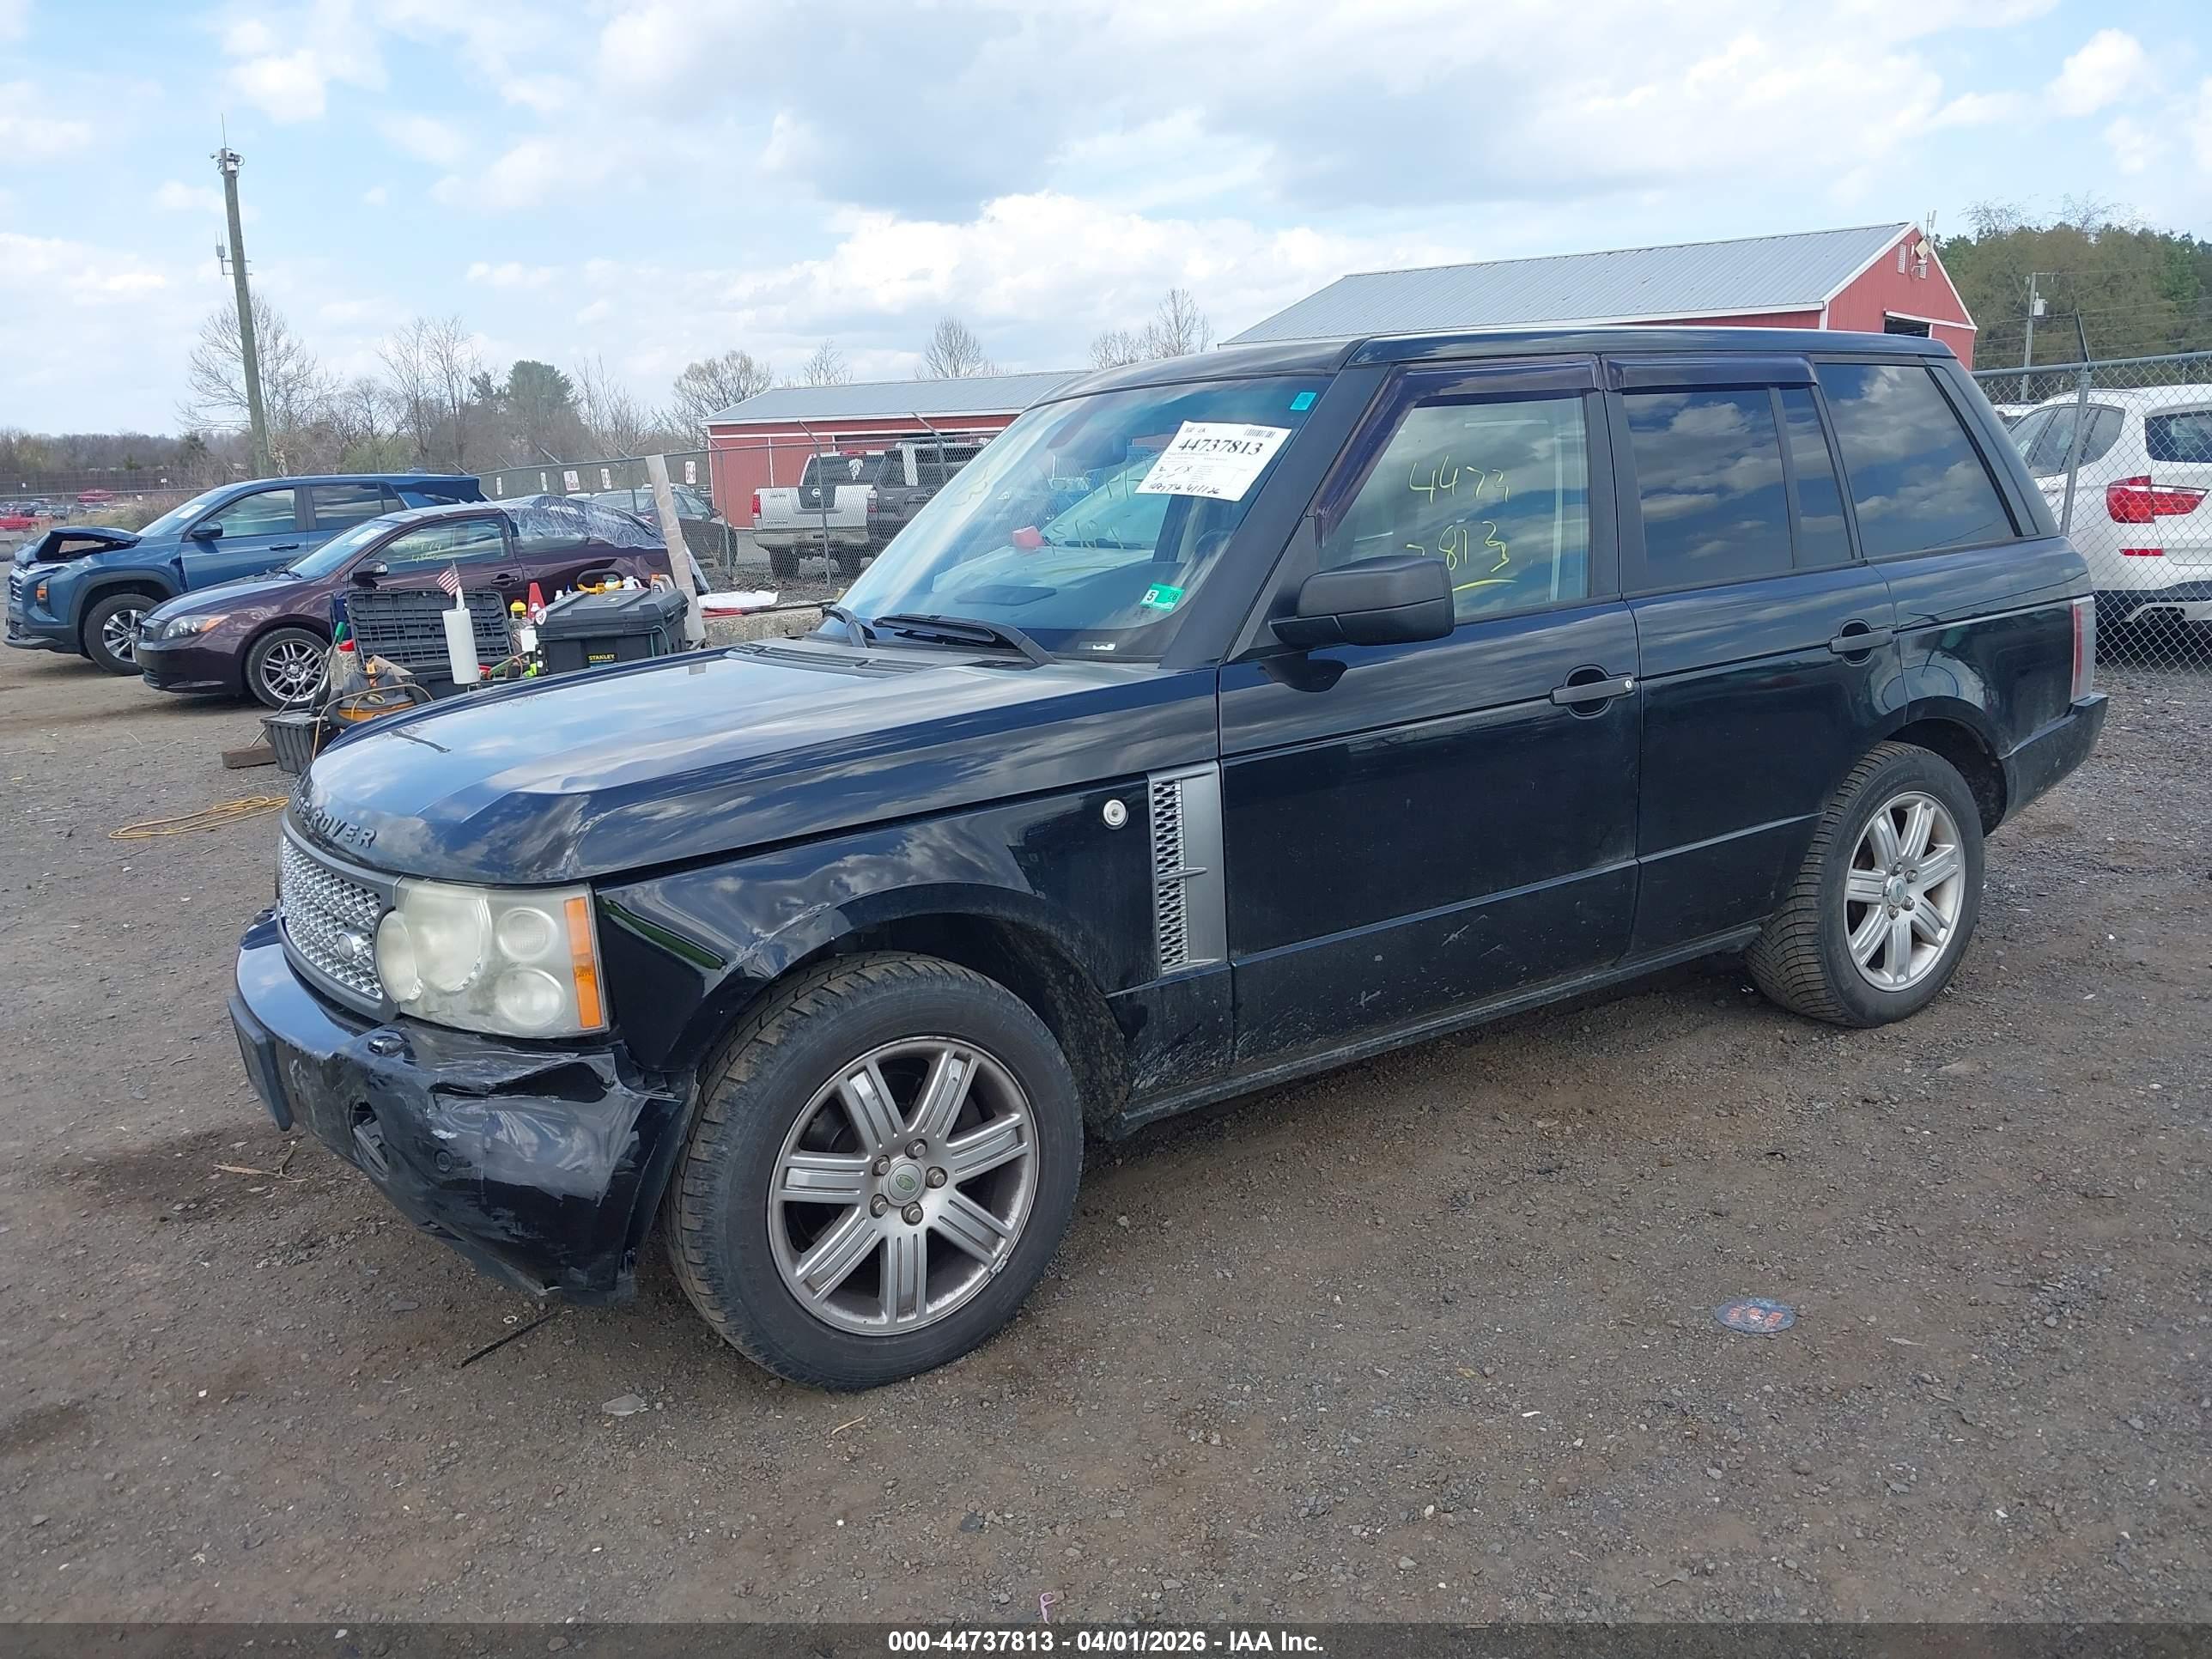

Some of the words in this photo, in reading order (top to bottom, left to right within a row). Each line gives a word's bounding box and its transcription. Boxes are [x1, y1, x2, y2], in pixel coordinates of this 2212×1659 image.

[1178, 438, 1264, 456] 44737813
[1147, 591, 1157, 601] 5
[588, 653, 616, 661] STANLEY
[310, 809, 378, 848] ROVER
